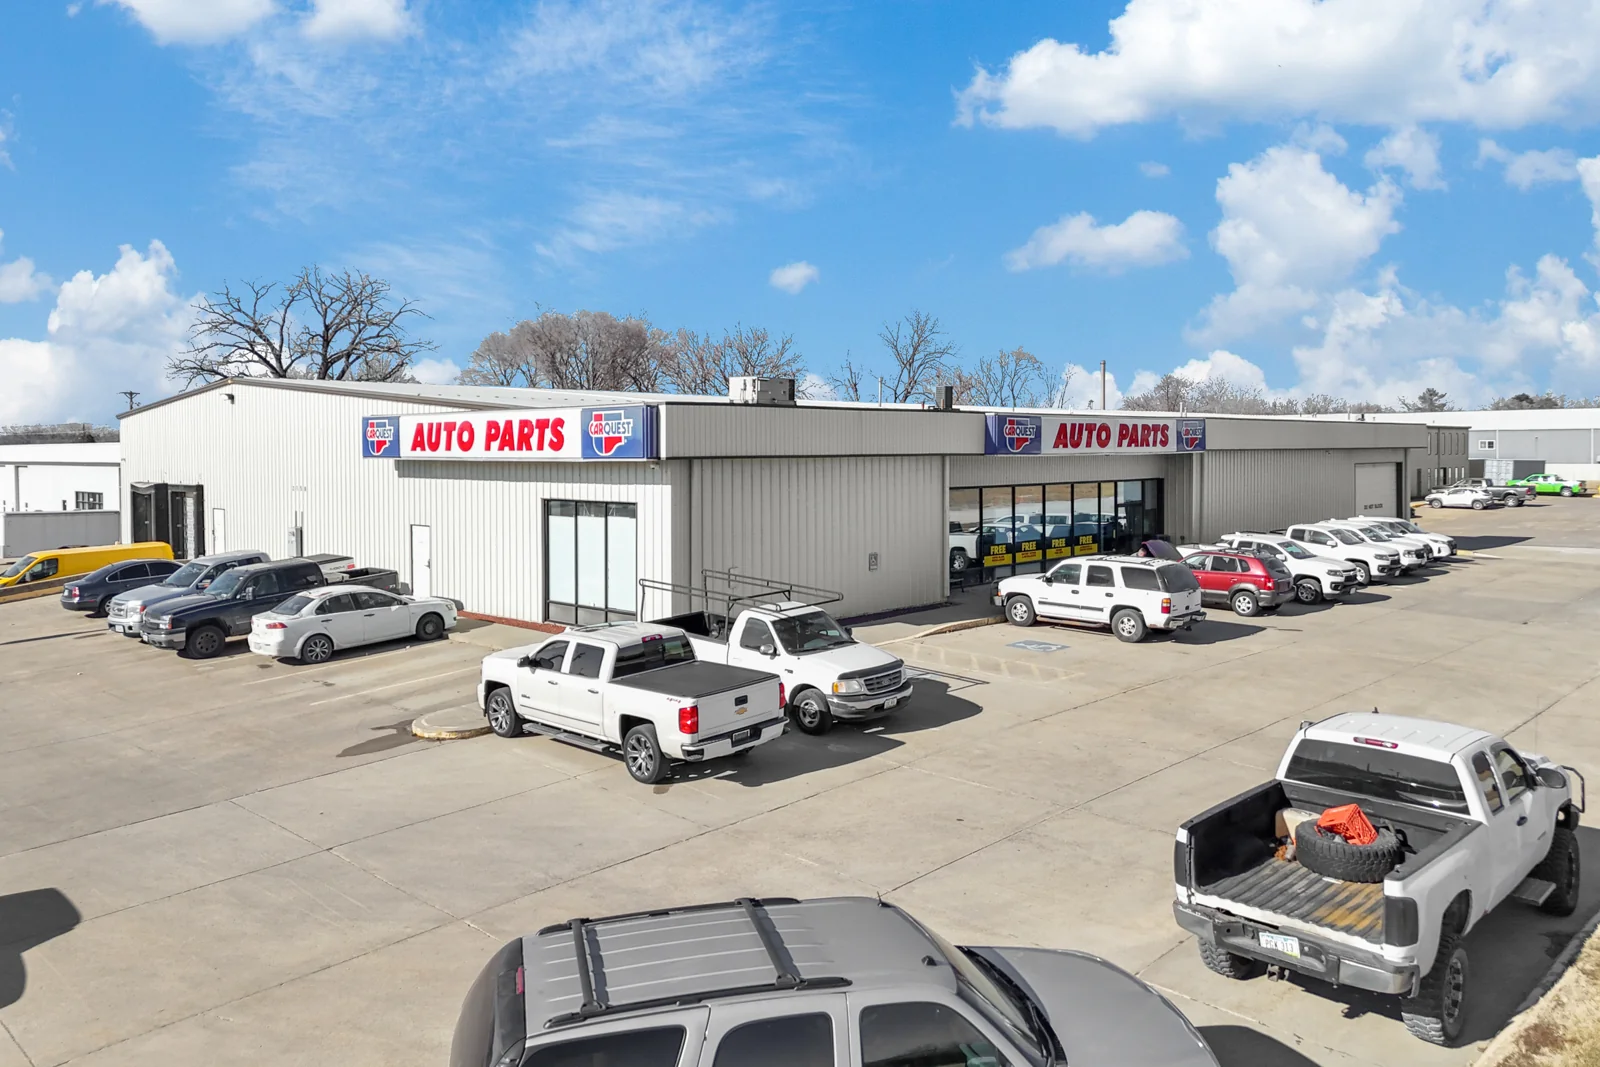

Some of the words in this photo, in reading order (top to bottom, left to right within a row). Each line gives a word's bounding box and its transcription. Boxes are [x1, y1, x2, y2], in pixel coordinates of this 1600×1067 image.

[366, 427, 392, 439] CARQUEST
[410, 420, 475, 452] AUTO
[484, 417, 565, 452] PARTS
[589, 421, 632, 436] CARQUEST
[1004, 425, 1036, 437] CARQUEST
[1052, 423, 1111, 448] AUTO
[1117, 423, 1169, 448] PARTS
[1051, 538, 1066, 548] FREE
[1079, 535, 1093, 544] FREE
[990, 544, 1007, 555] FREE
[1021, 541, 1037, 551] FREE
